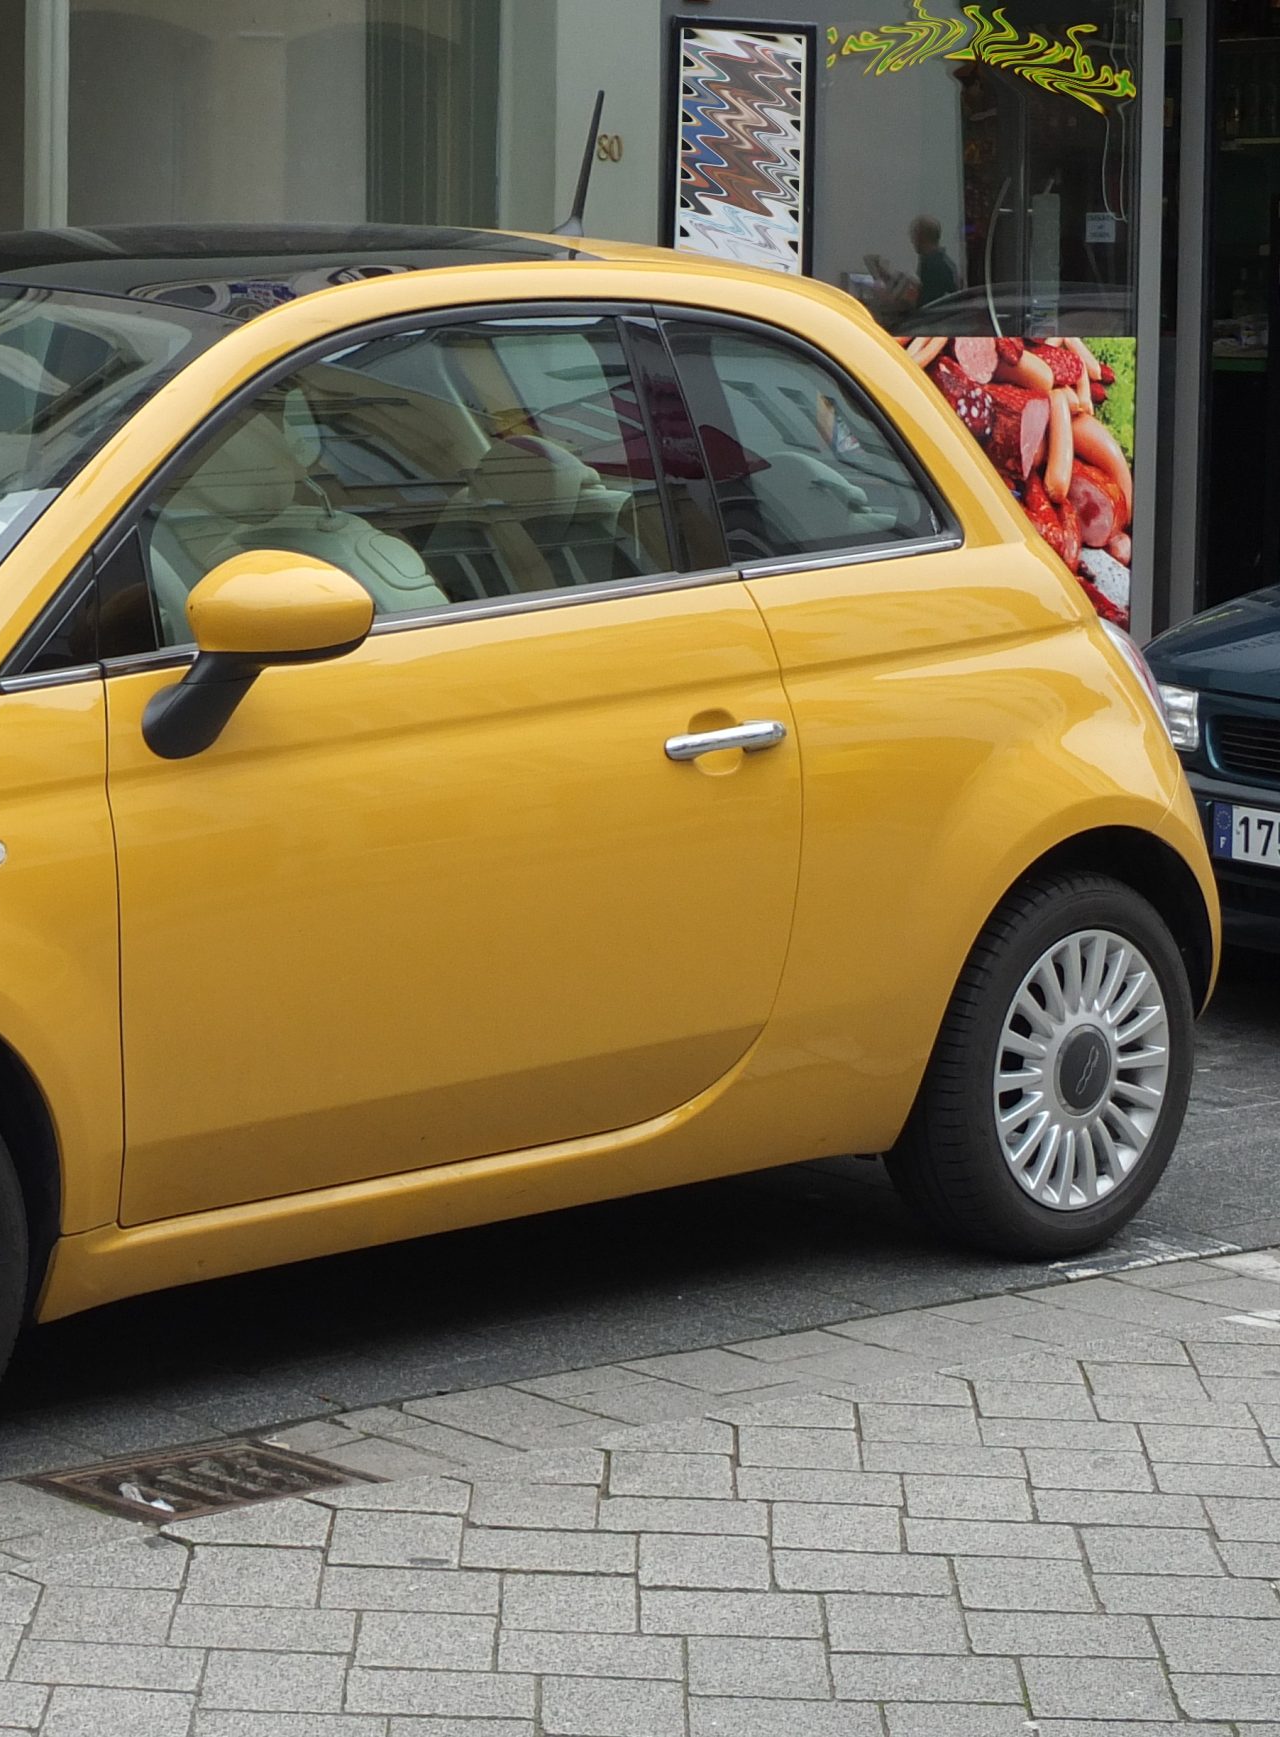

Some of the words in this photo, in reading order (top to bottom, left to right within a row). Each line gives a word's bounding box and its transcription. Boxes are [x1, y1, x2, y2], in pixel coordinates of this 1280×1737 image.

[597, 133, 624, 162] 80
[1220, 836, 1227, 849] F
[1239, 816, 1280, 857] 17
